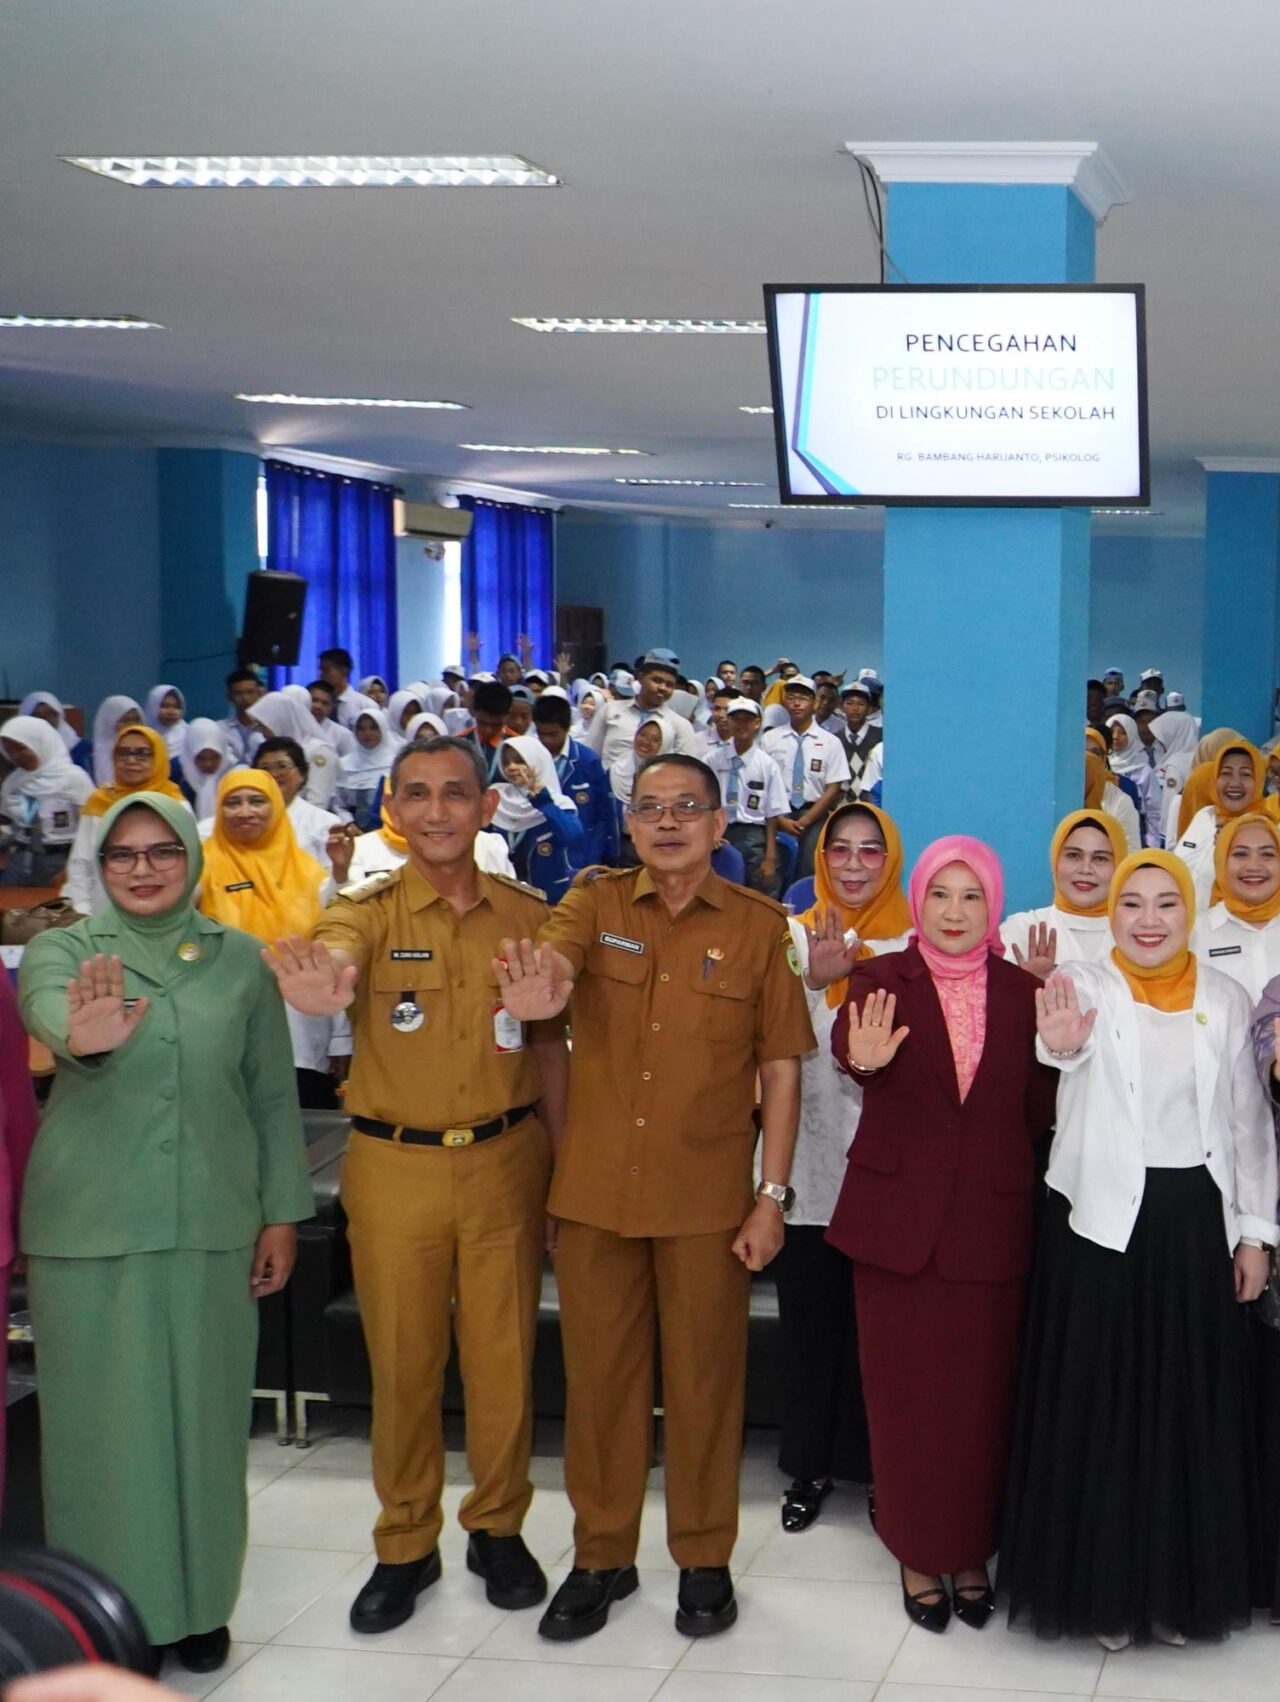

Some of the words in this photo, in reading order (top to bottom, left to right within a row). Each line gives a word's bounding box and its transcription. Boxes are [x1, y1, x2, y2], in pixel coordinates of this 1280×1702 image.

[905, 333, 1077, 353] PENCEGAHAN
[872, 366, 1115, 391] PERUNDUNGAN
[876, 405, 894, 420] DI
[899, 405, 1024, 421] LINGKUNGAN
[1029, 405, 1115, 421] SEKOLAH
[917, 452, 974, 463] BAMBANG
[1044, 453, 1101, 463] PSIKOLOG
